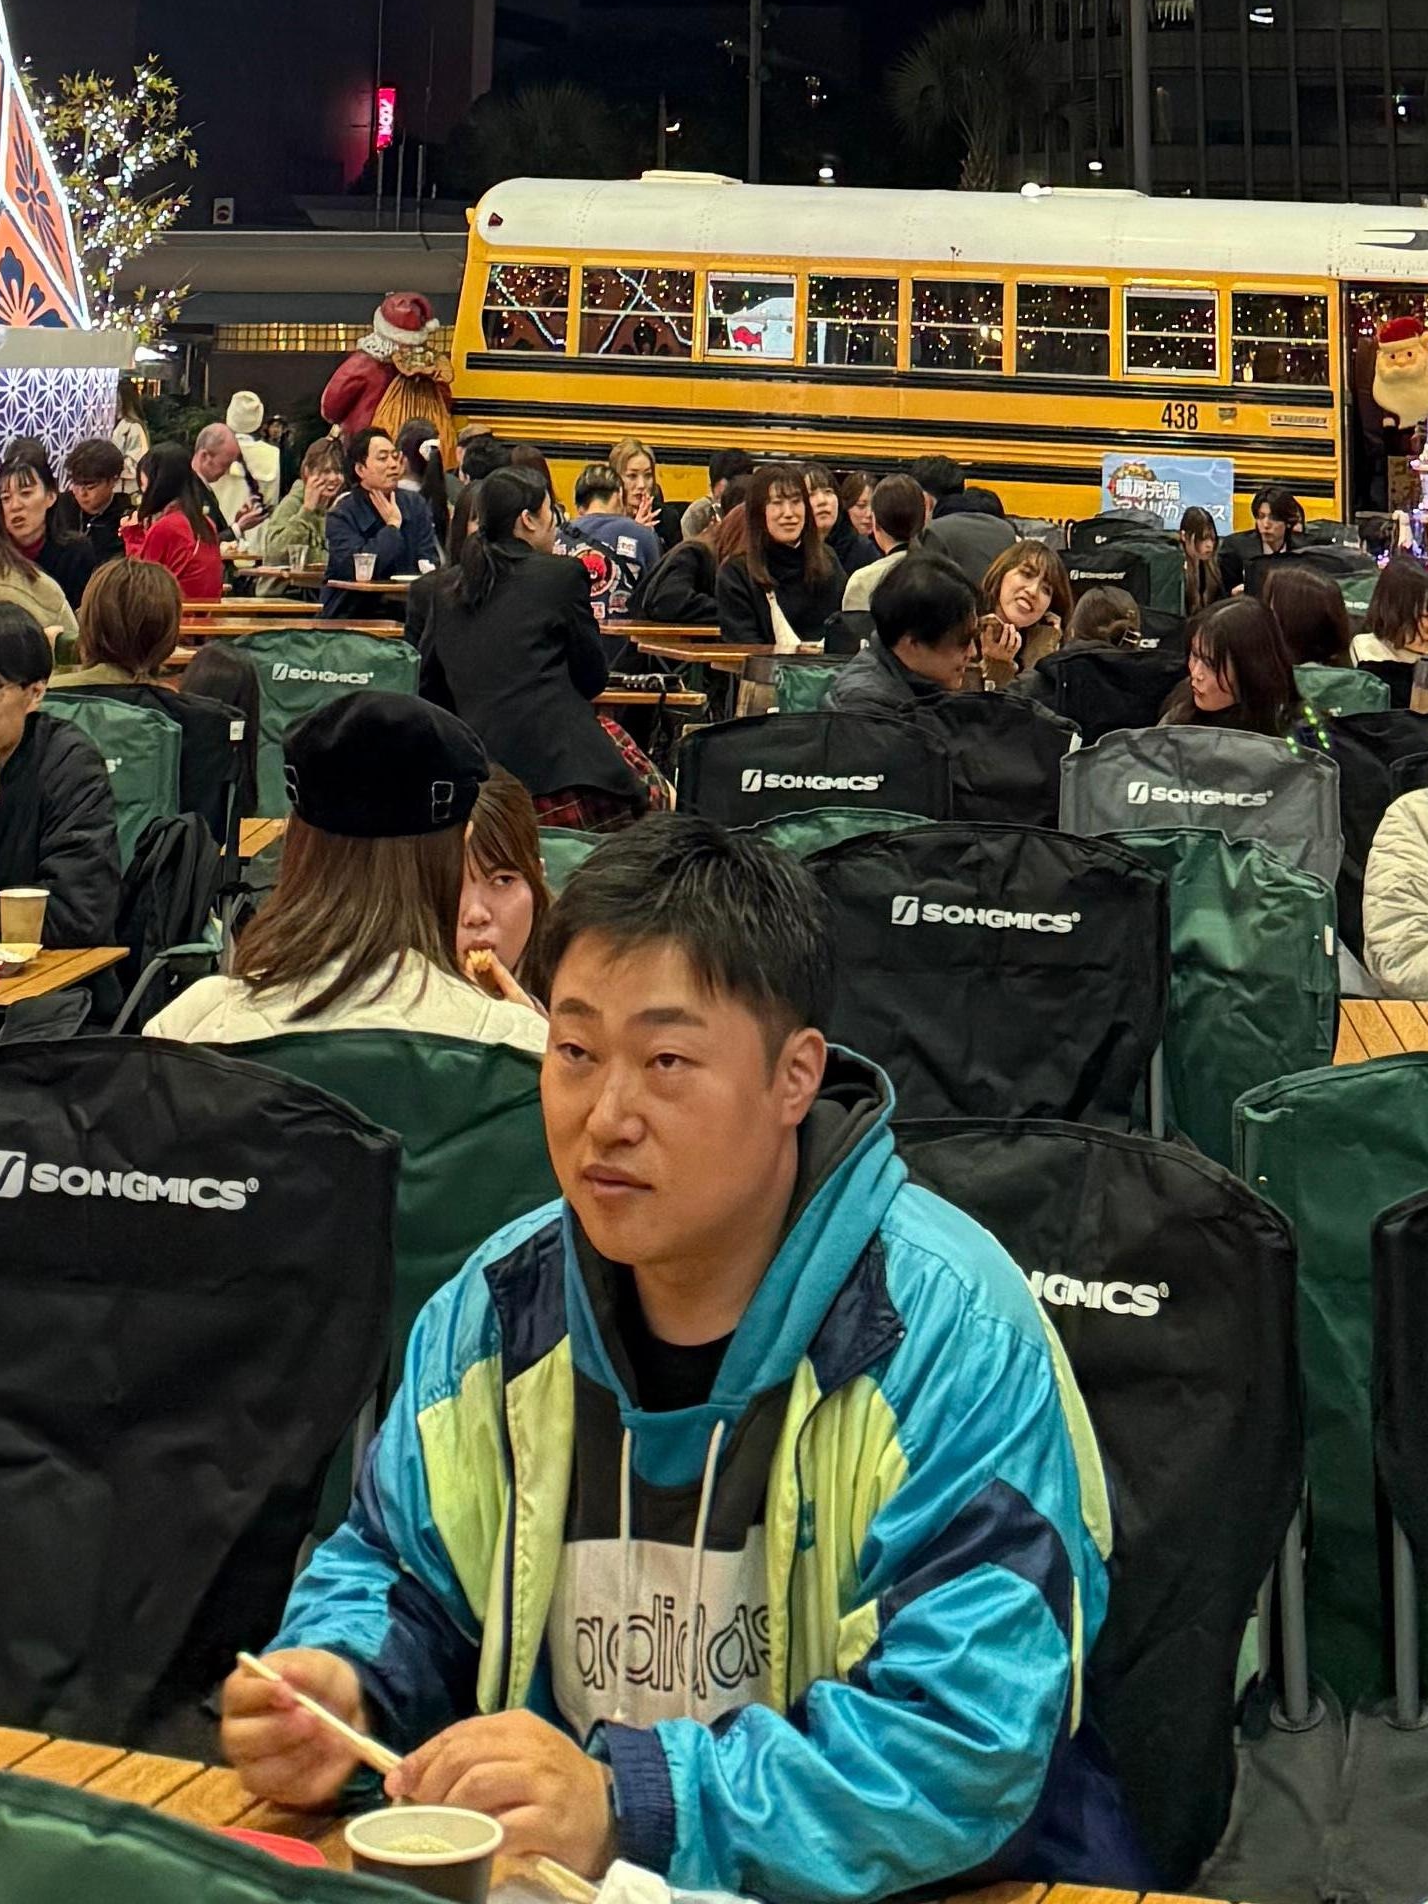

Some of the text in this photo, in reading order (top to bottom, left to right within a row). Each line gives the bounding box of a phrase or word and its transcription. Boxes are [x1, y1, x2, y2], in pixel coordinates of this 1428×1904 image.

[1161, 402, 1199, 430] 438
[764, 772, 879, 792] SONGMICS
[1151, 785, 1268, 808] SONGMICS
[922, 902, 1074, 934] SONGMICS
[28, 1162, 248, 1211] SONGMICS
